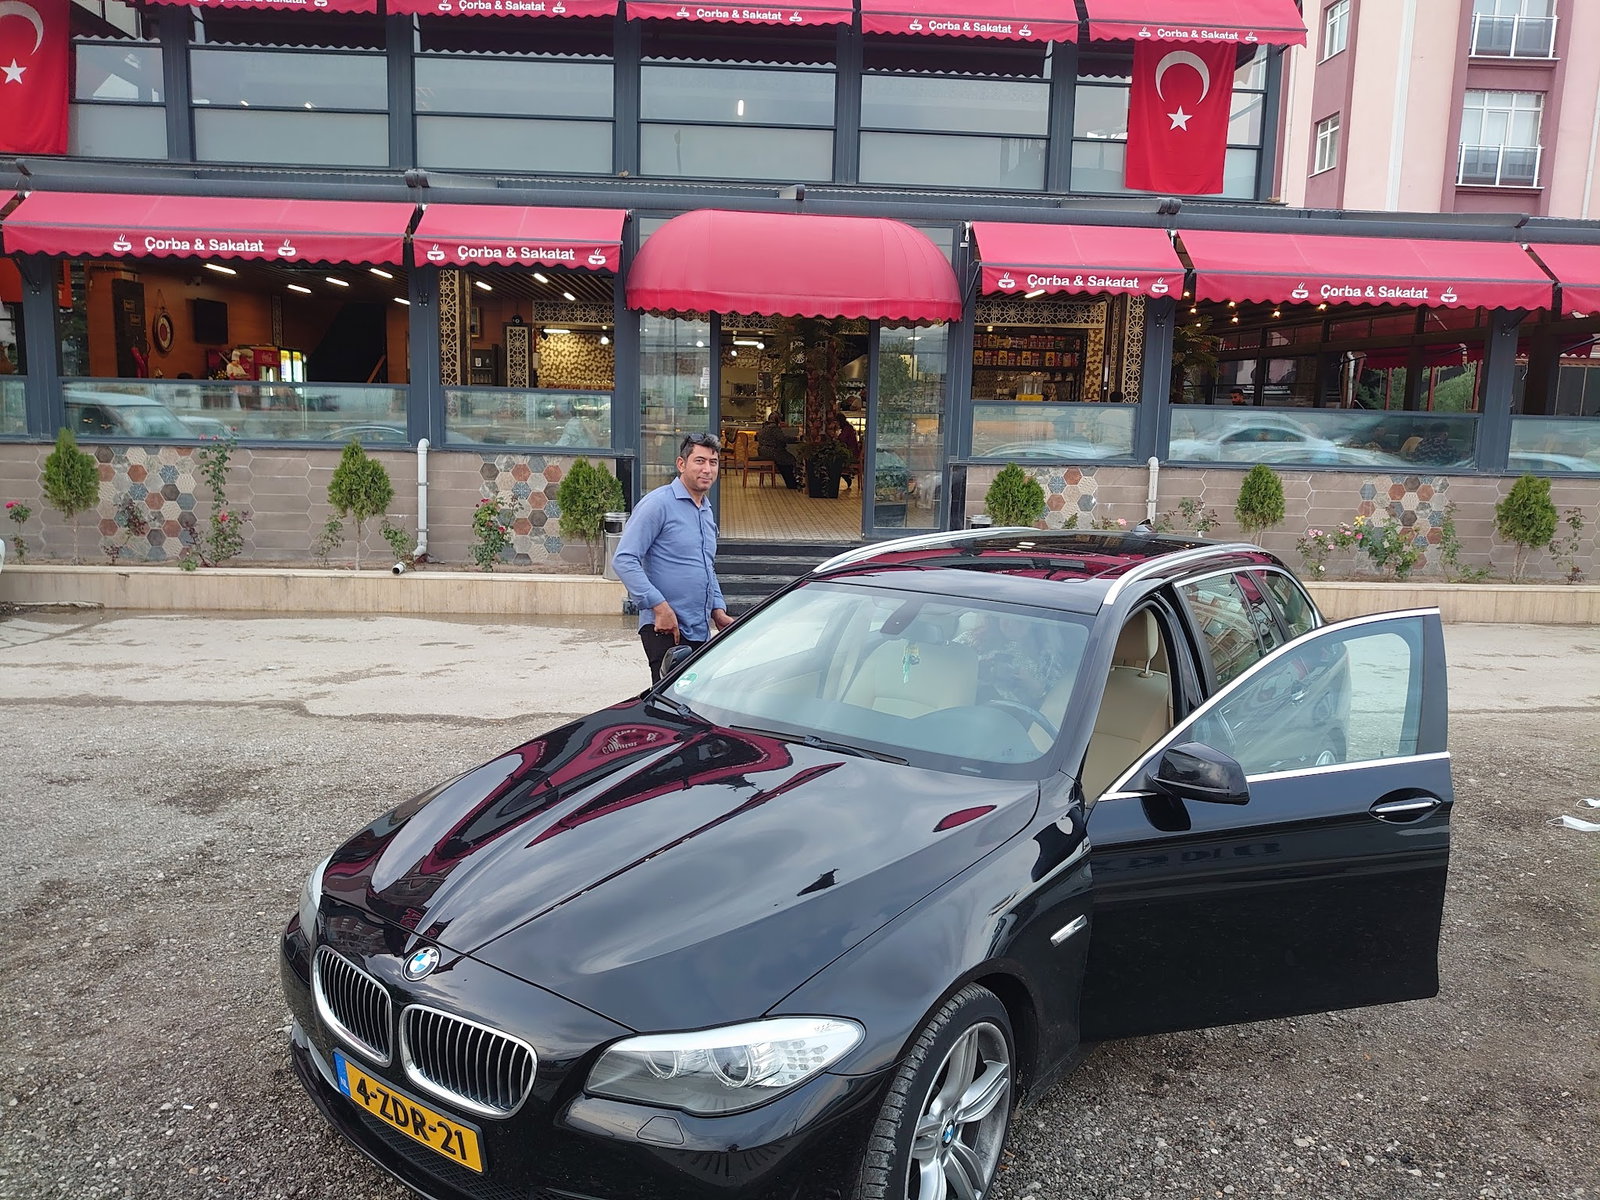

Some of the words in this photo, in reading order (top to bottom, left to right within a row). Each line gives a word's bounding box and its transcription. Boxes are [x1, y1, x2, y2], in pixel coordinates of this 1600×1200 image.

[458, 0, 492, 12] Çorba
[494, 0, 503, 10] &
[505, 0, 546, 11] Sakatat
[696, 8, 729, 19] Çorba
[731, 10, 740, 19] &
[742, 10, 782, 20] Sakatat
[928, 20, 961, 31] Çorba
[963, 22, 971, 31] &
[973, 22, 1012, 34] Sakatat
[1157, 28, 1188, 38] Çorba
[1190, 30, 1198, 38] &
[1201, 30, 1239, 40] Sakatat
[144, 236, 190, 252] Çorba
[194, 238, 205, 251] &
[209, 239, 264, 252] Sakatat
[457, 245, 502, 260] Çorba
[506, 247, 517, 259] &
[520, 247, 575, 260] Sakatat
[1027, 274, 1069, 288] Çorba
[1073, 275, 1084, 287] &
[1087, 276, 1139, 289] Sakatat
[1320, 284, 1361, 299] Çorba
[1365, 286, 1375, 297] &
[1378, 286, 1428, 299] Sakatat
[356, 1077, 467, 1160] 4-ZDR-21
